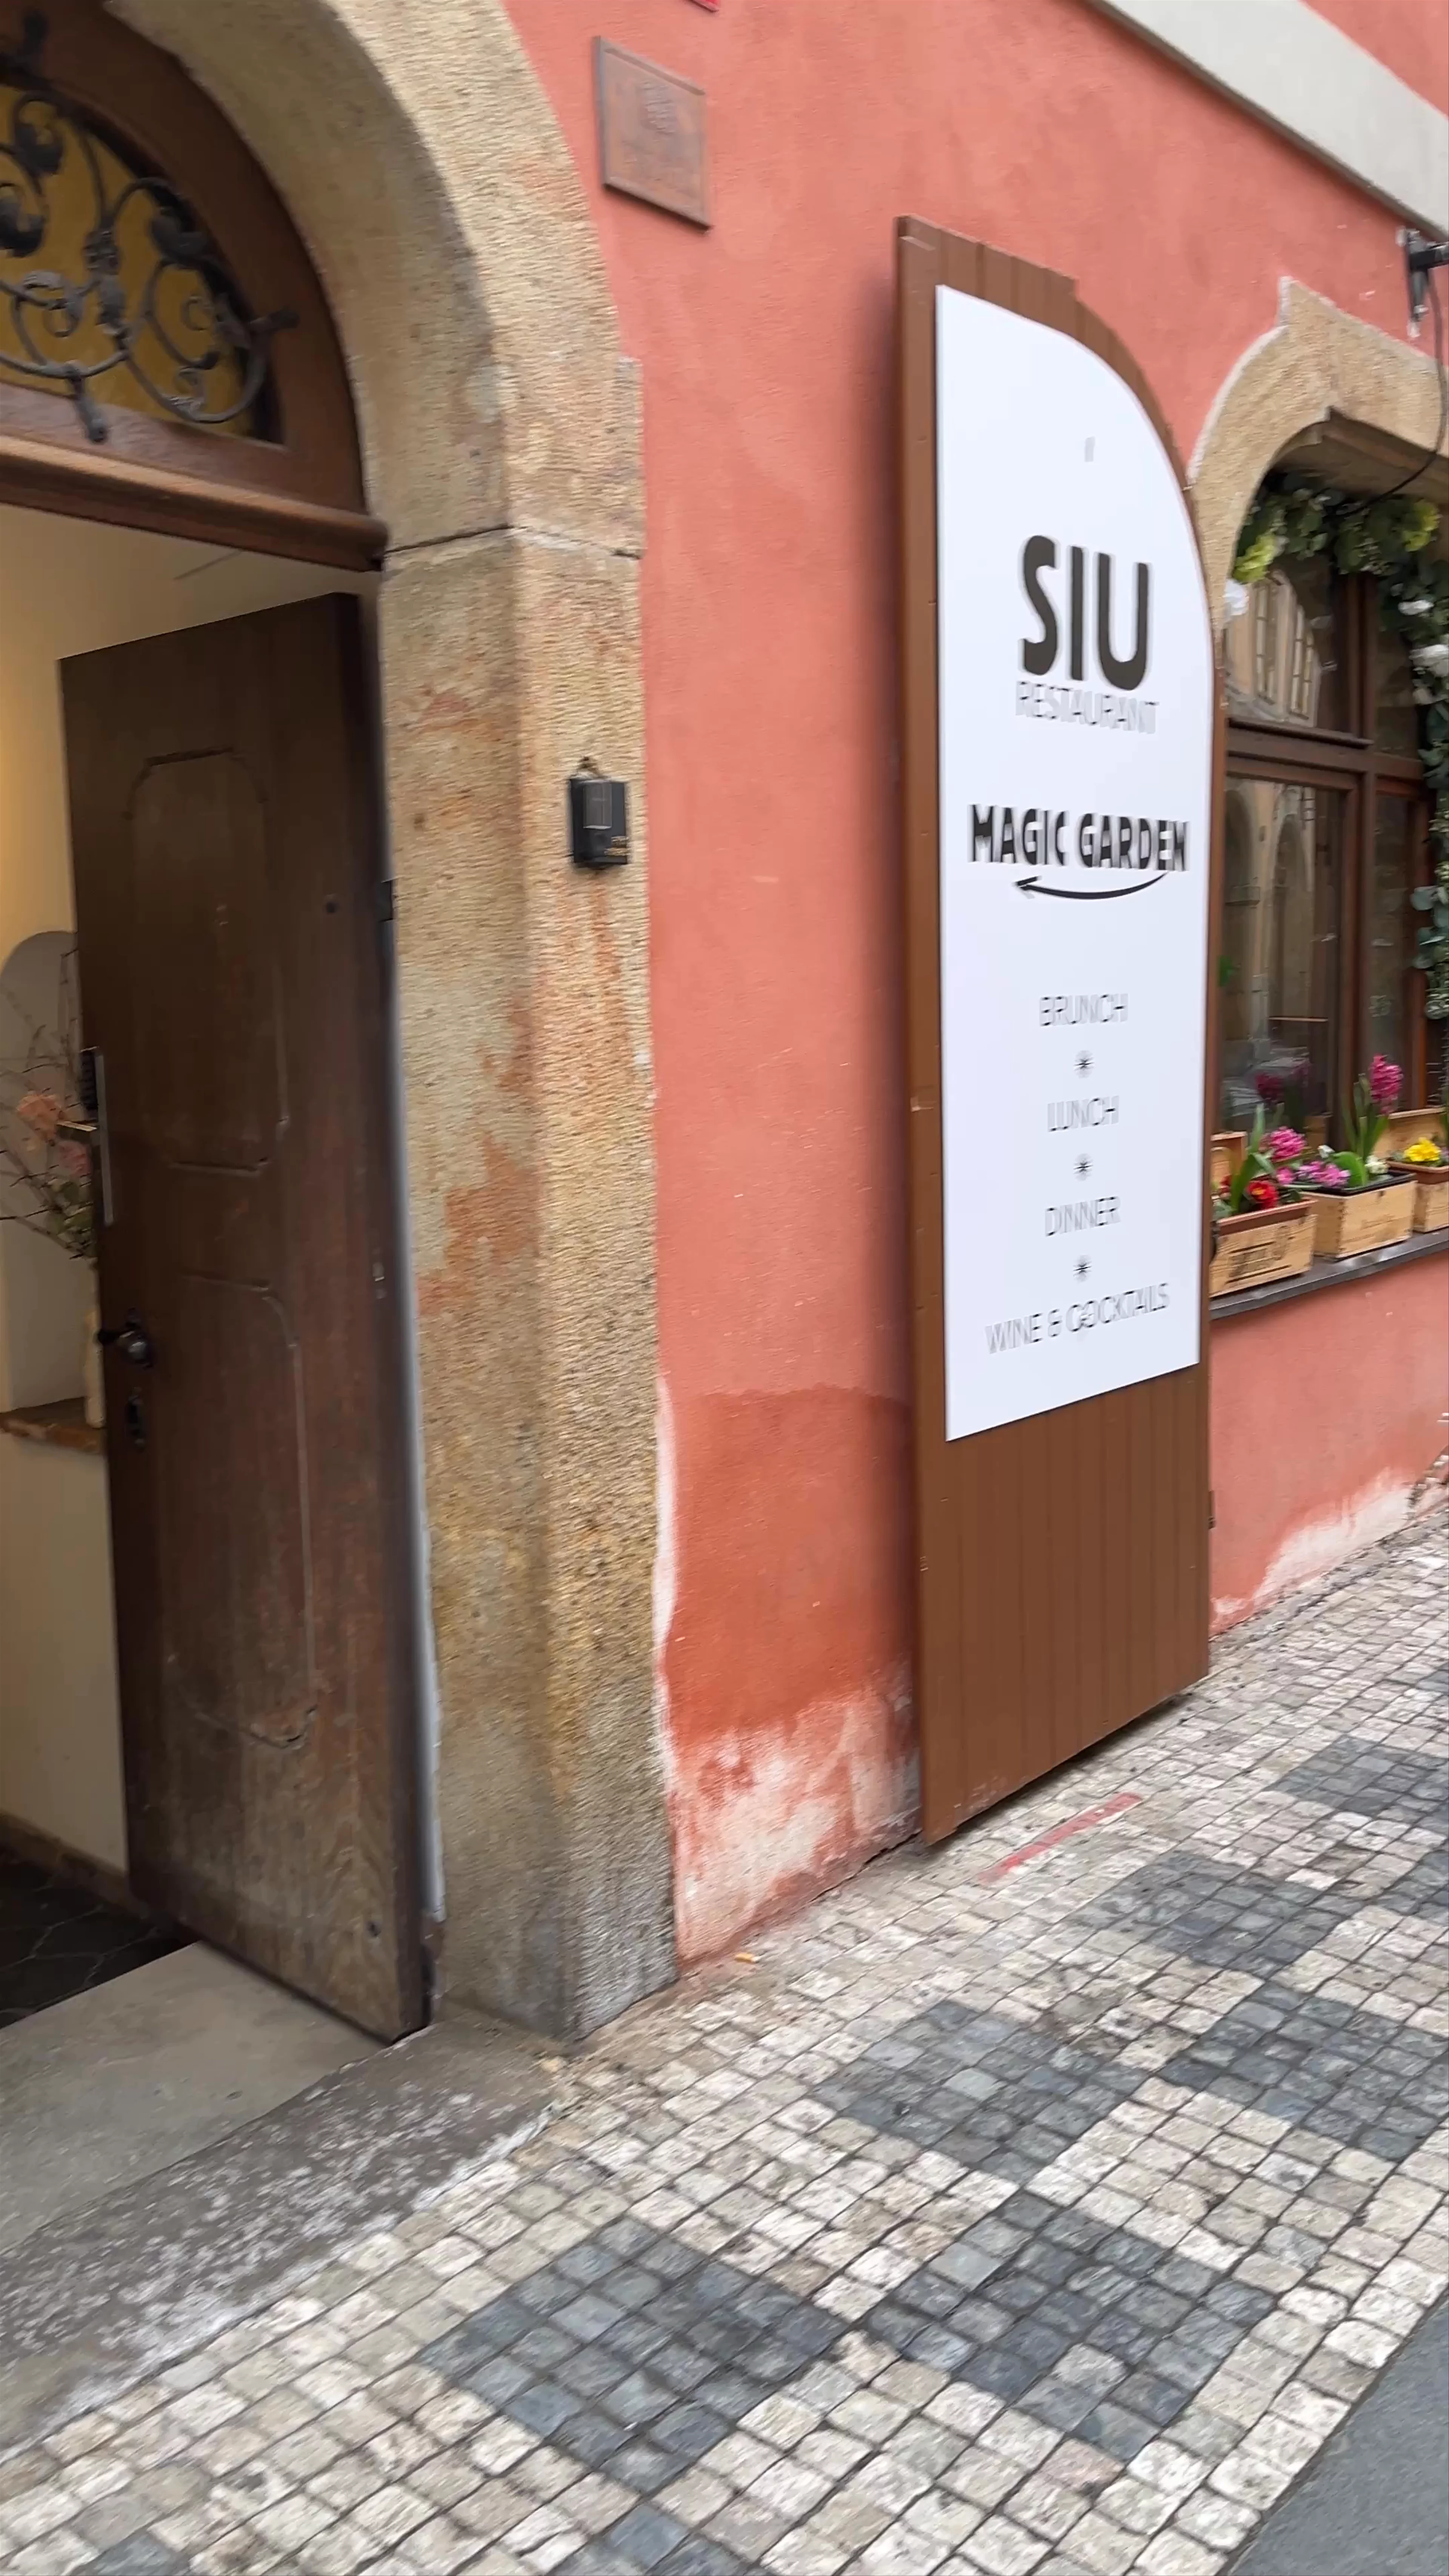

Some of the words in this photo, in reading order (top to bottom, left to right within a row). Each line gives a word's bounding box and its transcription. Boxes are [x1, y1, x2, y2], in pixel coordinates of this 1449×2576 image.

[1018, 534, 1152, 691] SIU
[1014, 680, 1159, 734] RESTAURANT
[968, 804, 1069, 866] MAGIC
[1075, 813, 1190, 871] GARDEN
[1039, 993, 1129, 1026] BRUNCH
[1046, 1095, 1120, 1132] LUNCH
[1044, 1196, 1121, 1237] DINNER
[985, 1312, 1042, 1354] WINE
[1047, 1309, 1062, 1337] &
[1066, 1282, 1171, 1333] COCKTAILS
